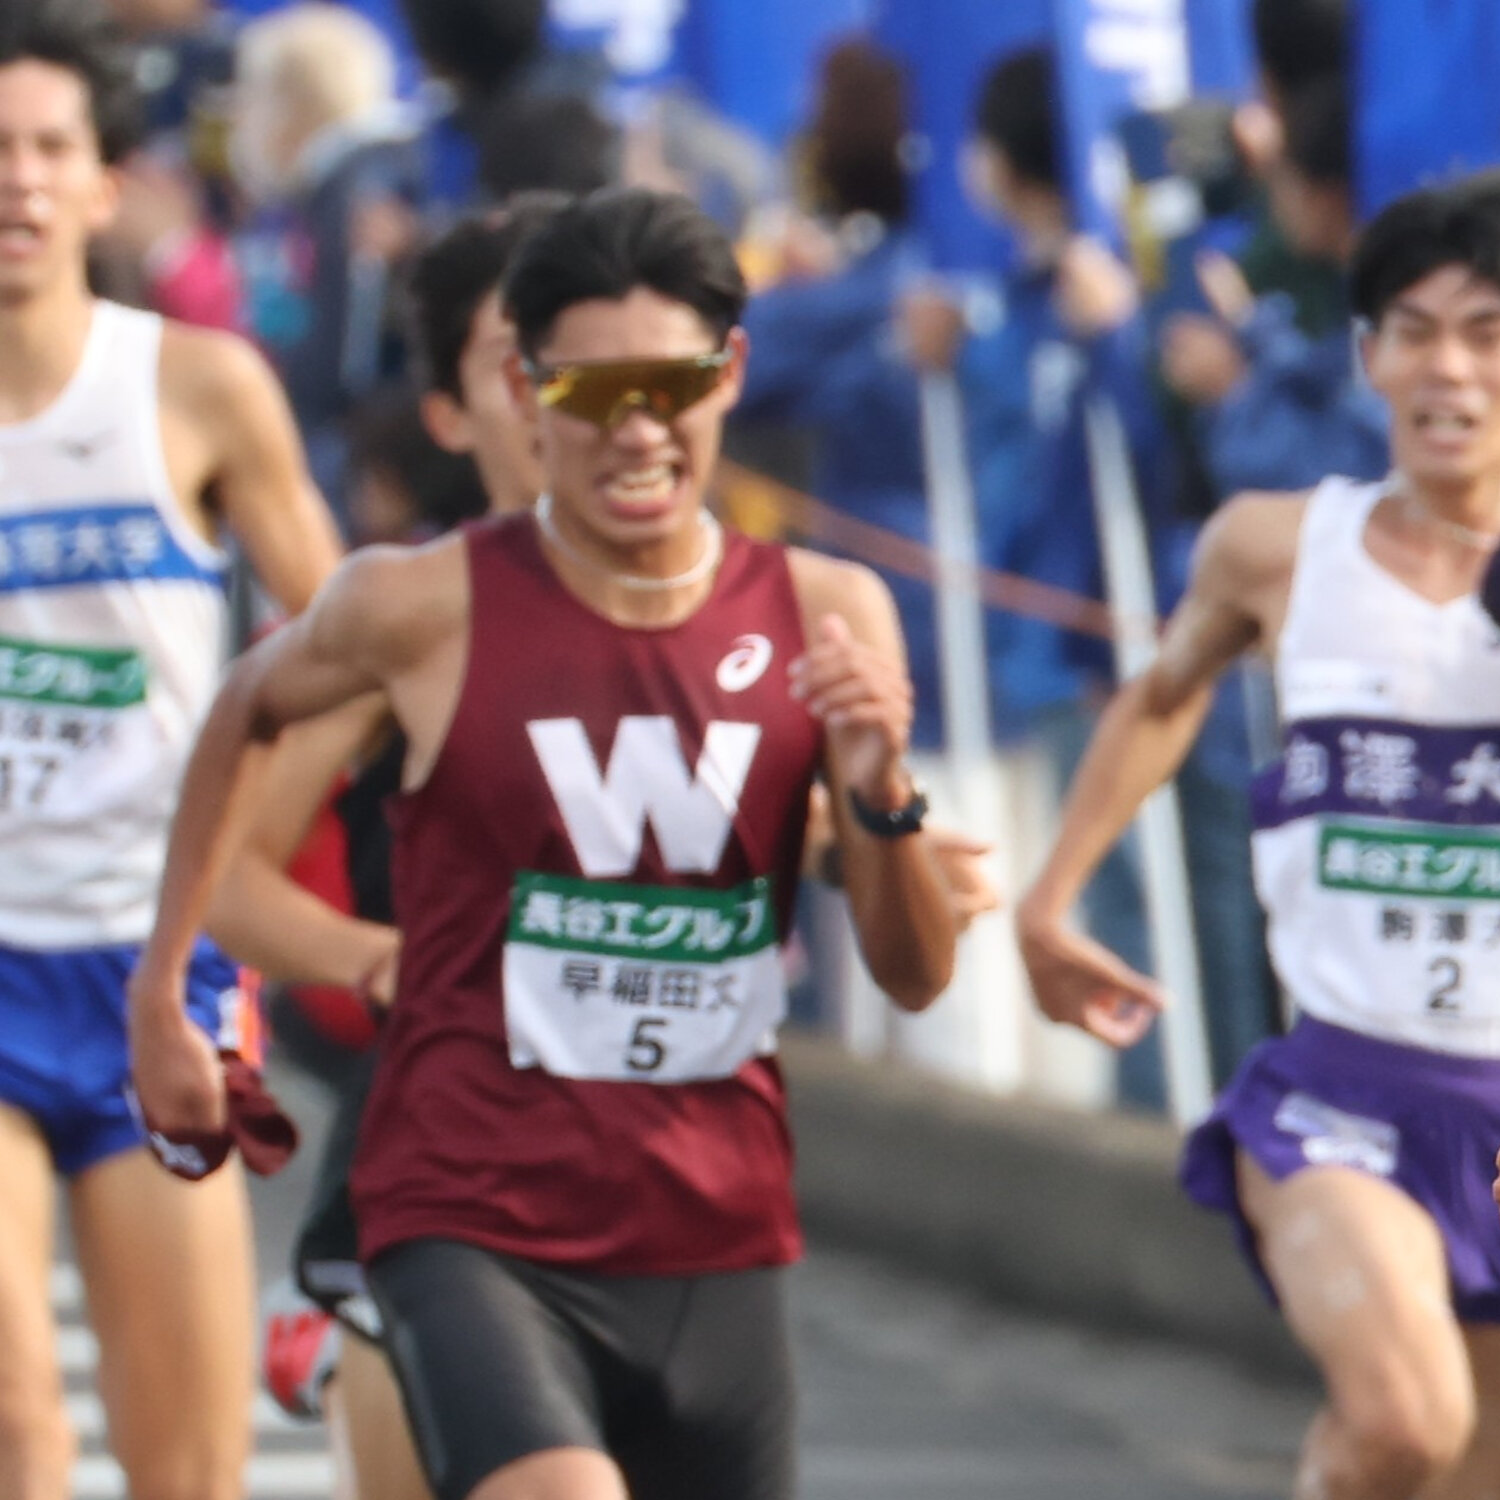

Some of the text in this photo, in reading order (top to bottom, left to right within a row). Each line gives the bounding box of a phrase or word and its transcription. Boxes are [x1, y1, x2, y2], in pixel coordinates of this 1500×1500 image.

[525, 715, 763, 878] W
[1426, 955, 1462, 1011] 2
[625, 1016, 668, 1072] 5
